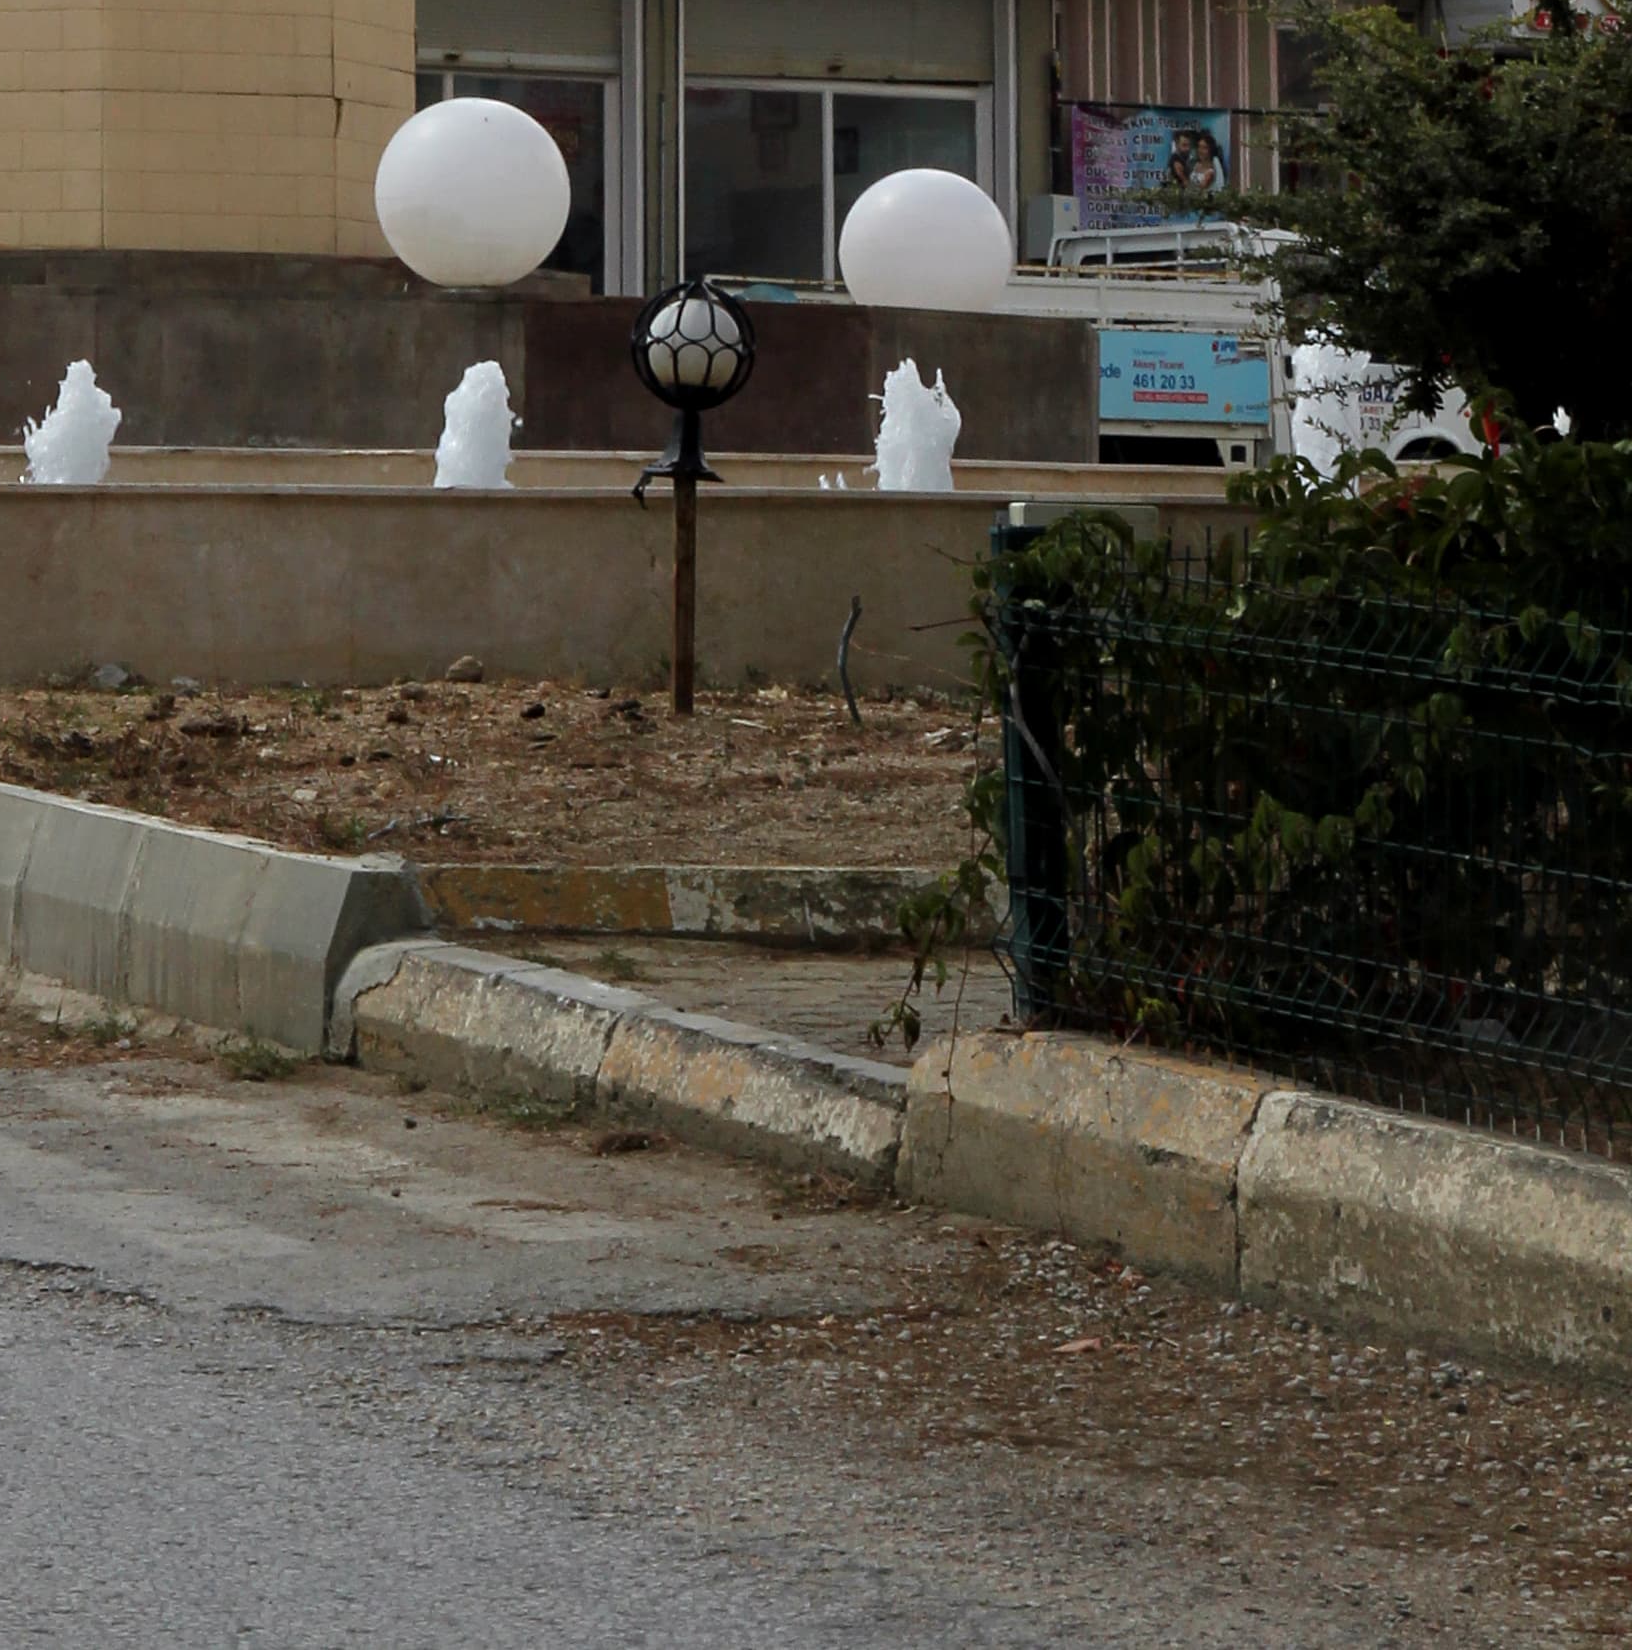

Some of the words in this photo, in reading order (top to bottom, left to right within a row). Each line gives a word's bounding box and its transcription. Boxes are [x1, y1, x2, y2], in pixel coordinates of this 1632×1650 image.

[1133, 374, 1155, 388] 461
[1161, 375, 1175, 390] 20
[1180, 375, 1195, 390] 33
